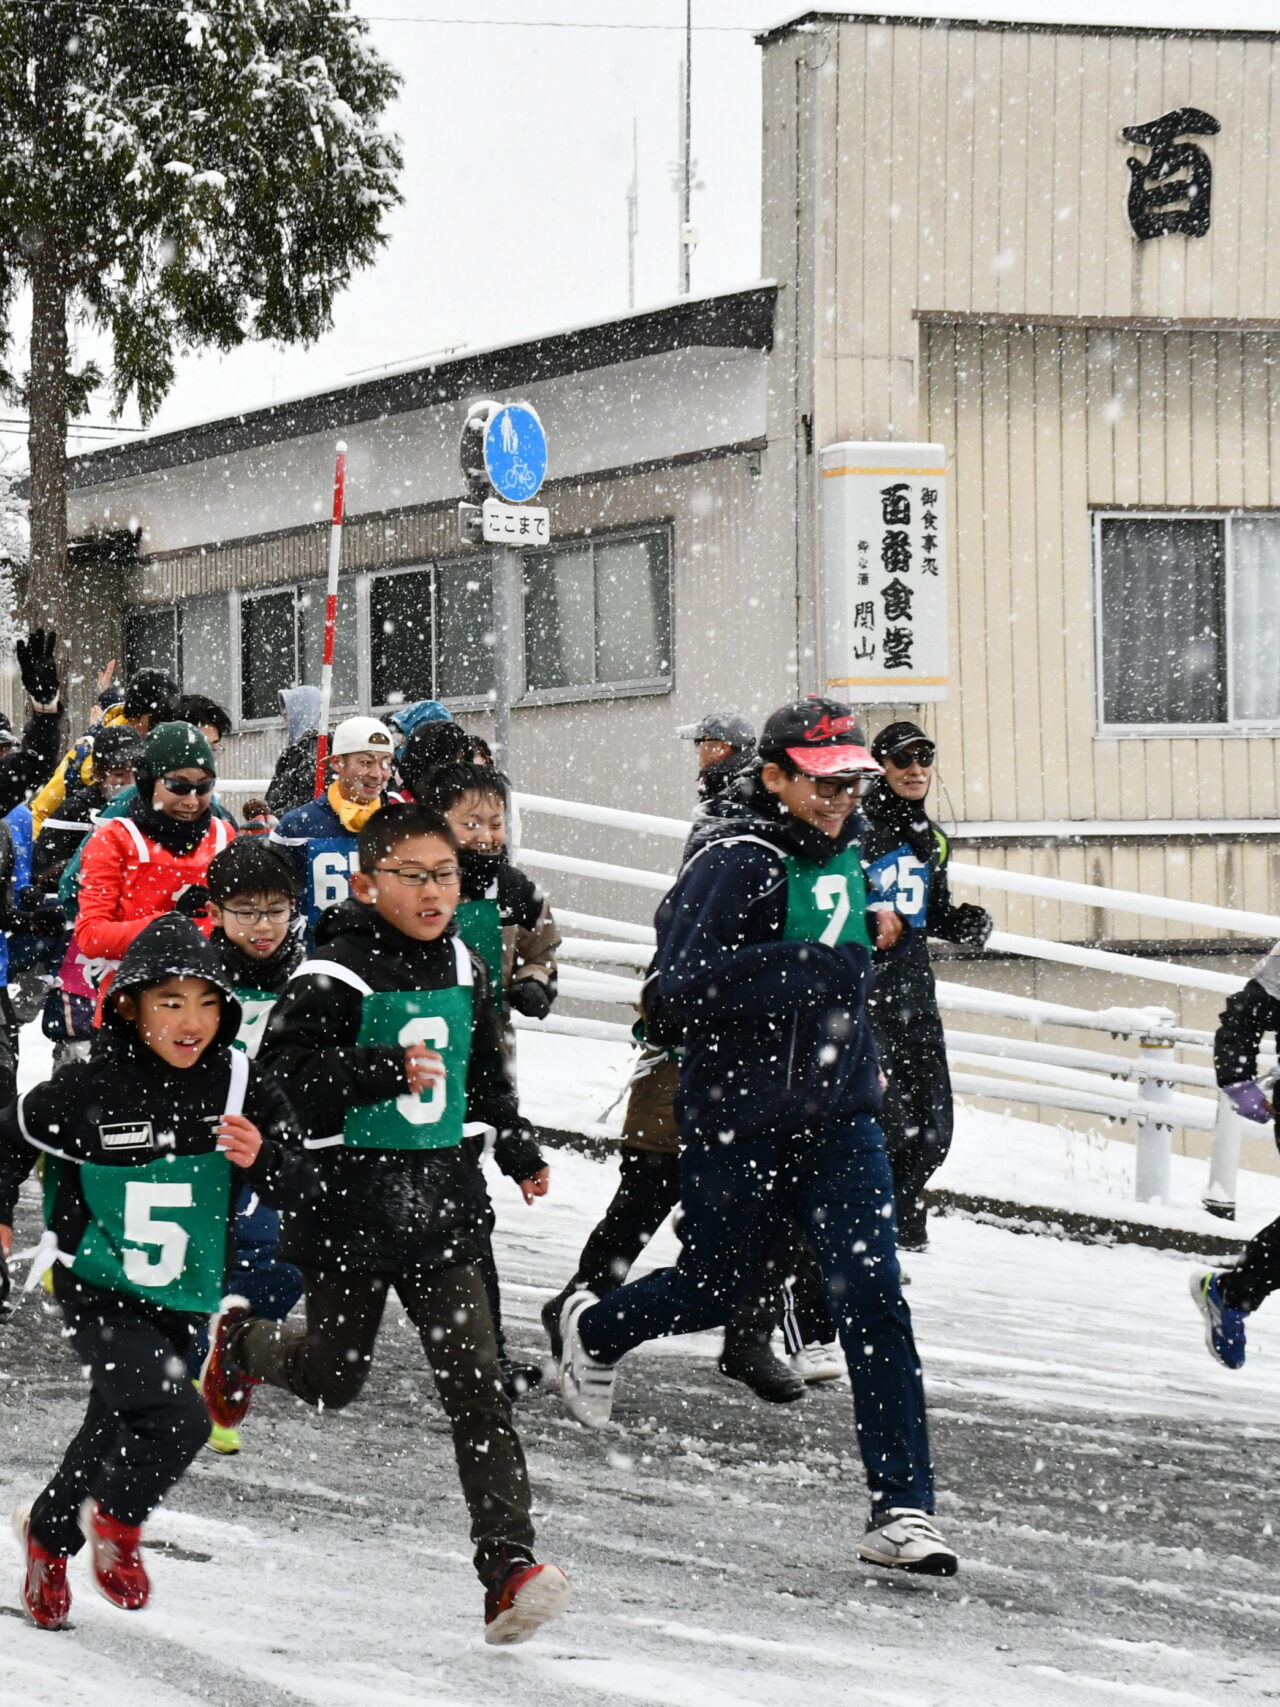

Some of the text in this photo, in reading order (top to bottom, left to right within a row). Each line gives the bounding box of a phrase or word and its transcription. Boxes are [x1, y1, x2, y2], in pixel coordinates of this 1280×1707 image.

[1121, 107, 1221, 241] 百
[489, 514, 546, 536] ここまで
[919, 487, 939, 576] 御食事処
[814, 874, 850, 948] 7
[122, 1182, 193, 1287] 5
